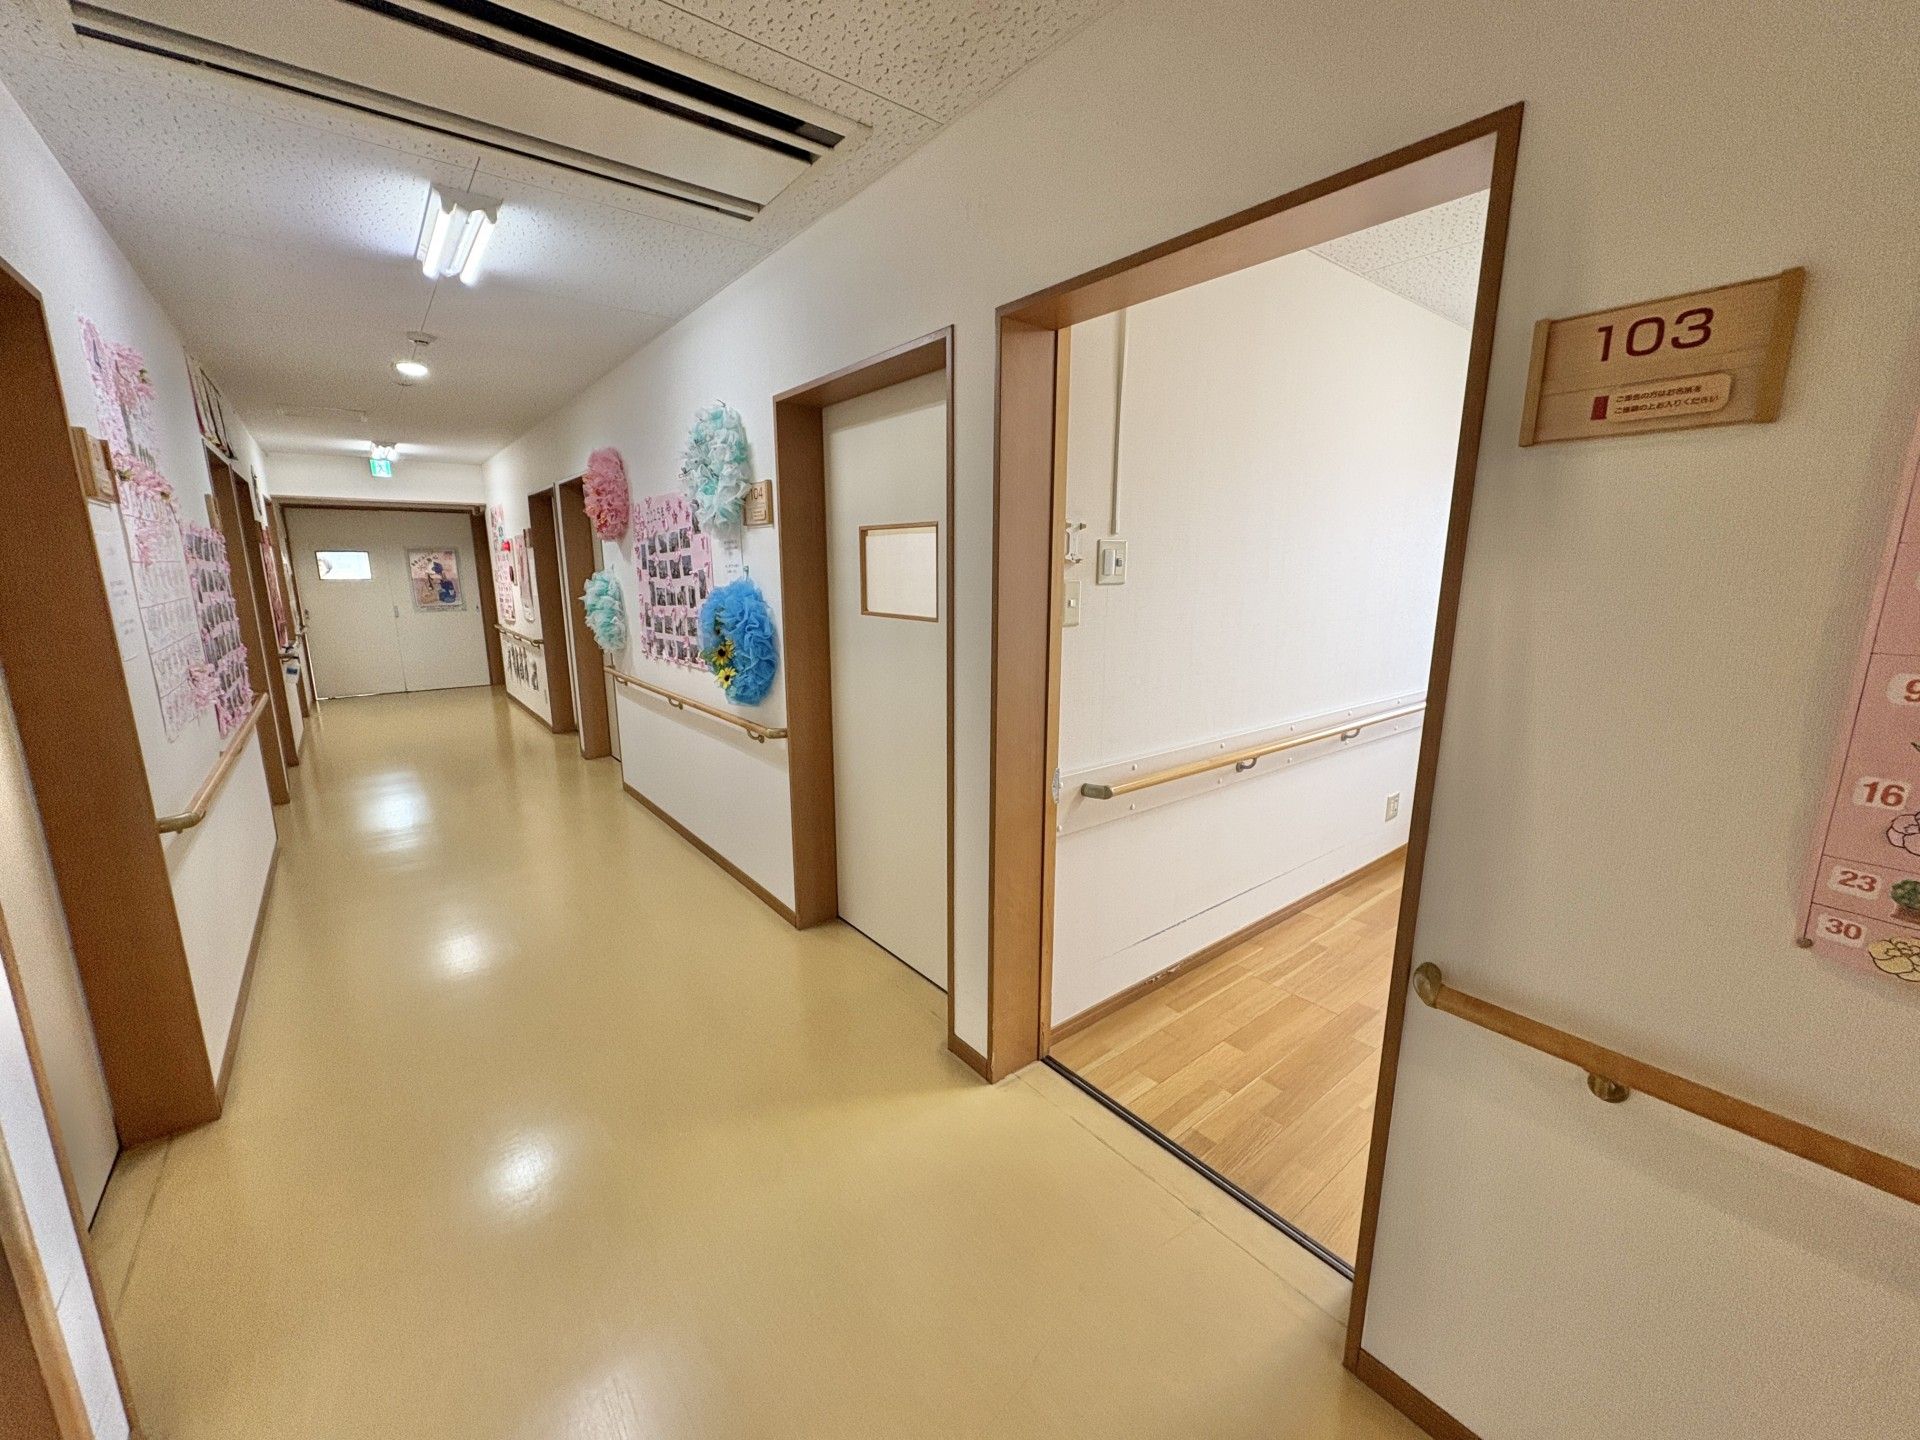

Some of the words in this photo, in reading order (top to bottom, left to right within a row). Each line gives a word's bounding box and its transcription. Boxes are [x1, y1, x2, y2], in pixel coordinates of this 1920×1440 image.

[1597, 307, 1714, 362] 103
[1863, 781, 1905, 807] 16
[1838, 870, 1877, 893] 23
[1825, 918, 1862, 940] 30
